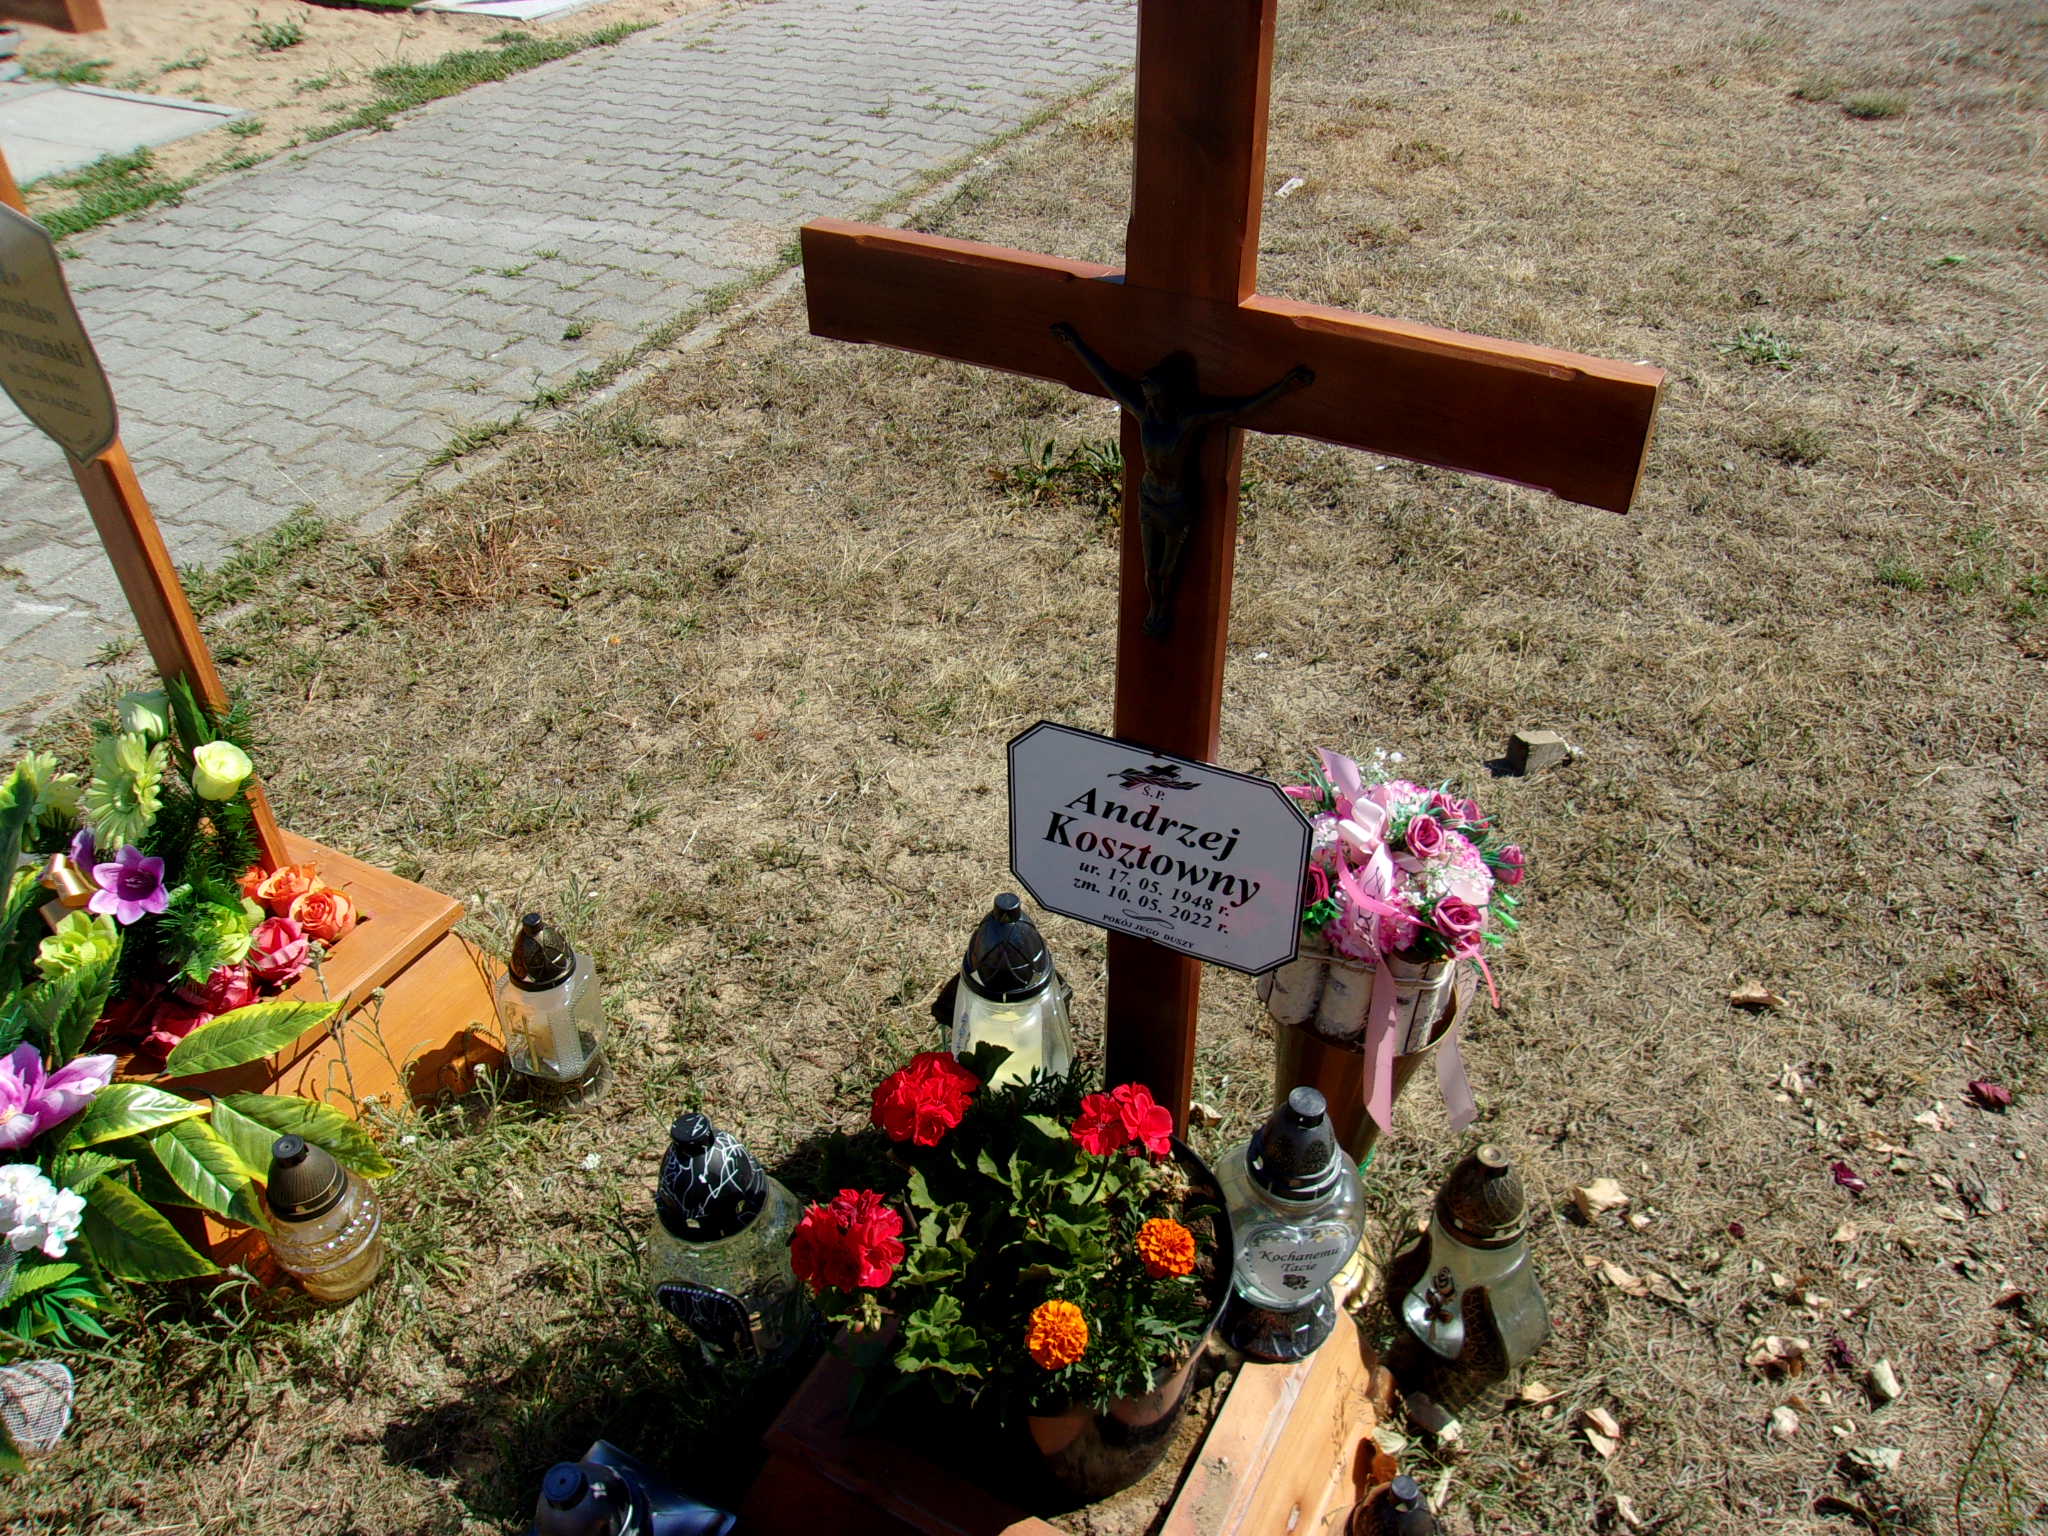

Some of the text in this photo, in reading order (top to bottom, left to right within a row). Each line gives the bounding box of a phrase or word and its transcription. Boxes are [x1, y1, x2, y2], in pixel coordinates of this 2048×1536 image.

[1064, 787, 1240, 862] Andrzej
[1042, 811, 1261, 907] Kosztowny
[1073, 877, 1229, 934] zm. 10. 05. 2022 r.
[1079, 862, 1230, 917] ur. 17. 05. 1948 r.
[1102, 914, 1195, 949] POKÓJ JEGO DUSZY
[1259, 1247, 1340, 1263] Kochanemu
[1281, 1263, 1318, 1272] Tacie
